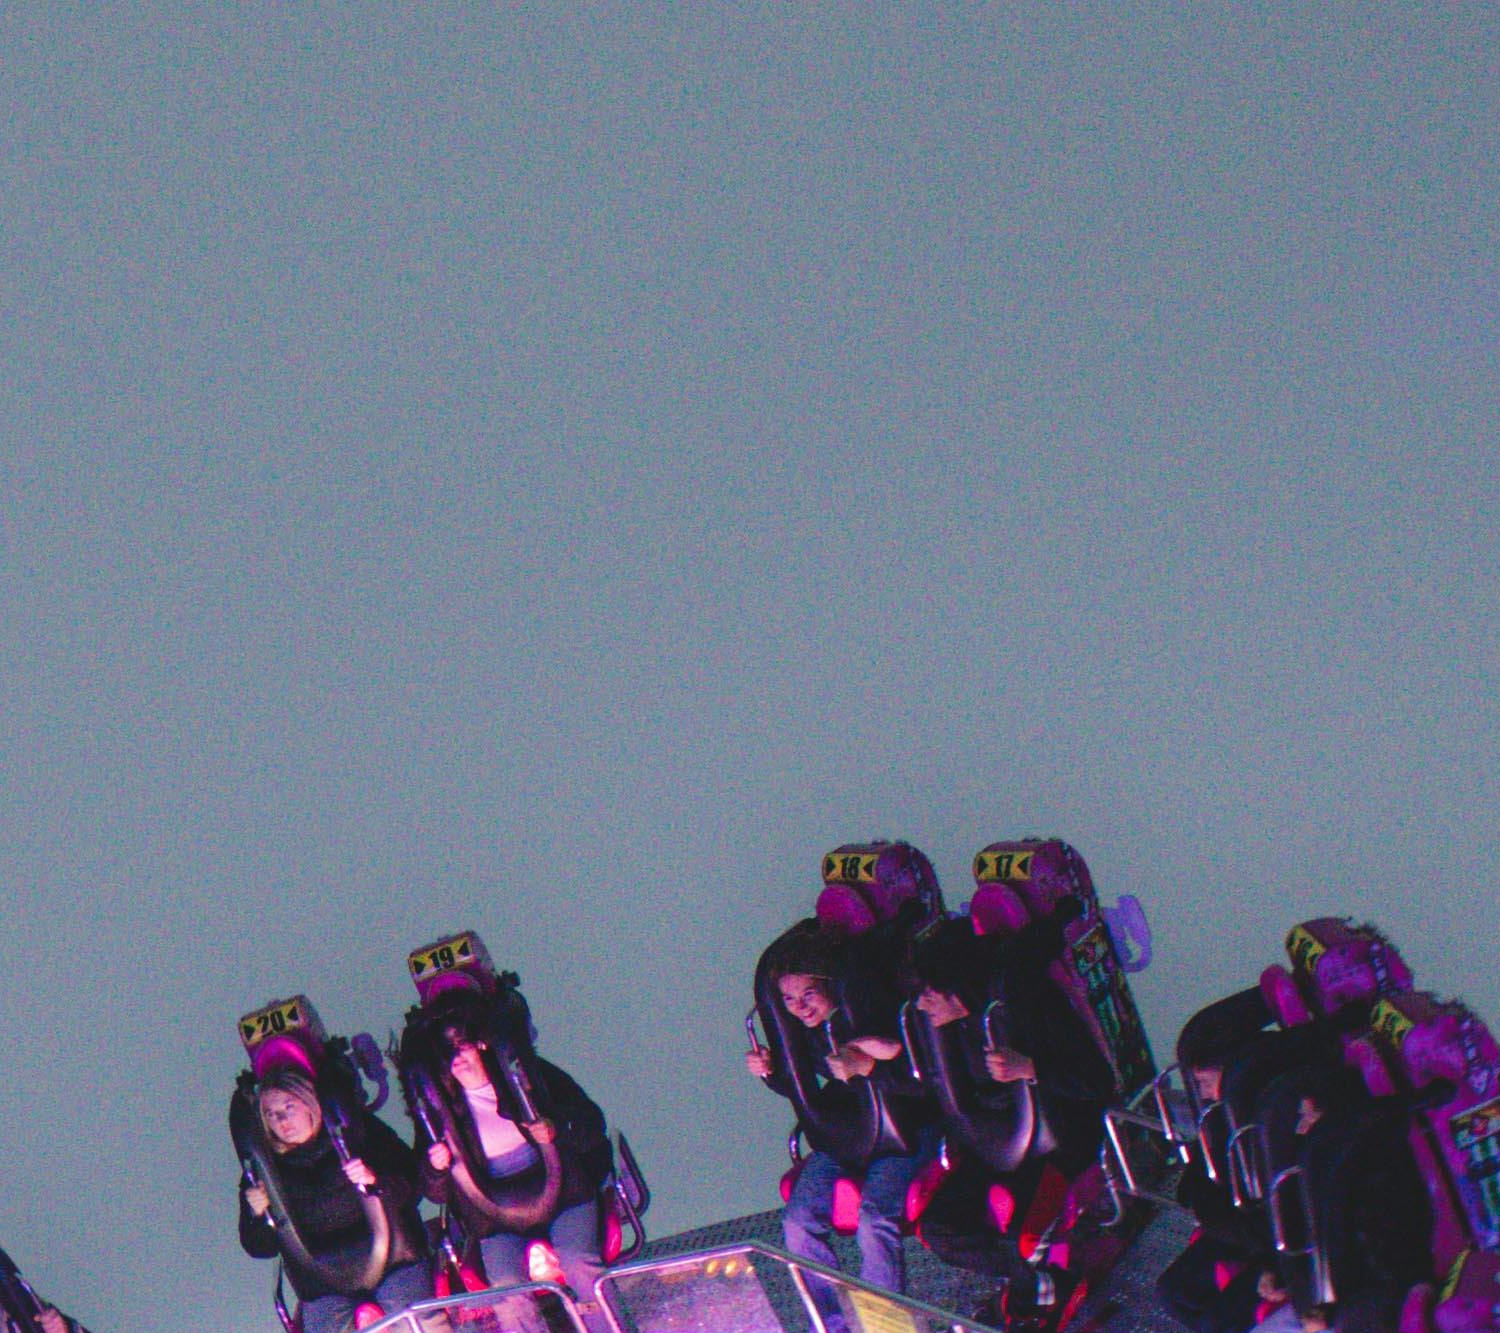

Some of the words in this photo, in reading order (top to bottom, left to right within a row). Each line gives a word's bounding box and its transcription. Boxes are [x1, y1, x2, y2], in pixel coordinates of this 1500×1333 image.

[839, 855, 862, 880] 18
[994, 854, 1014, 880] 17
[428, 946, 455, 969] 19
[256, 1010, 286, 1033] 20
